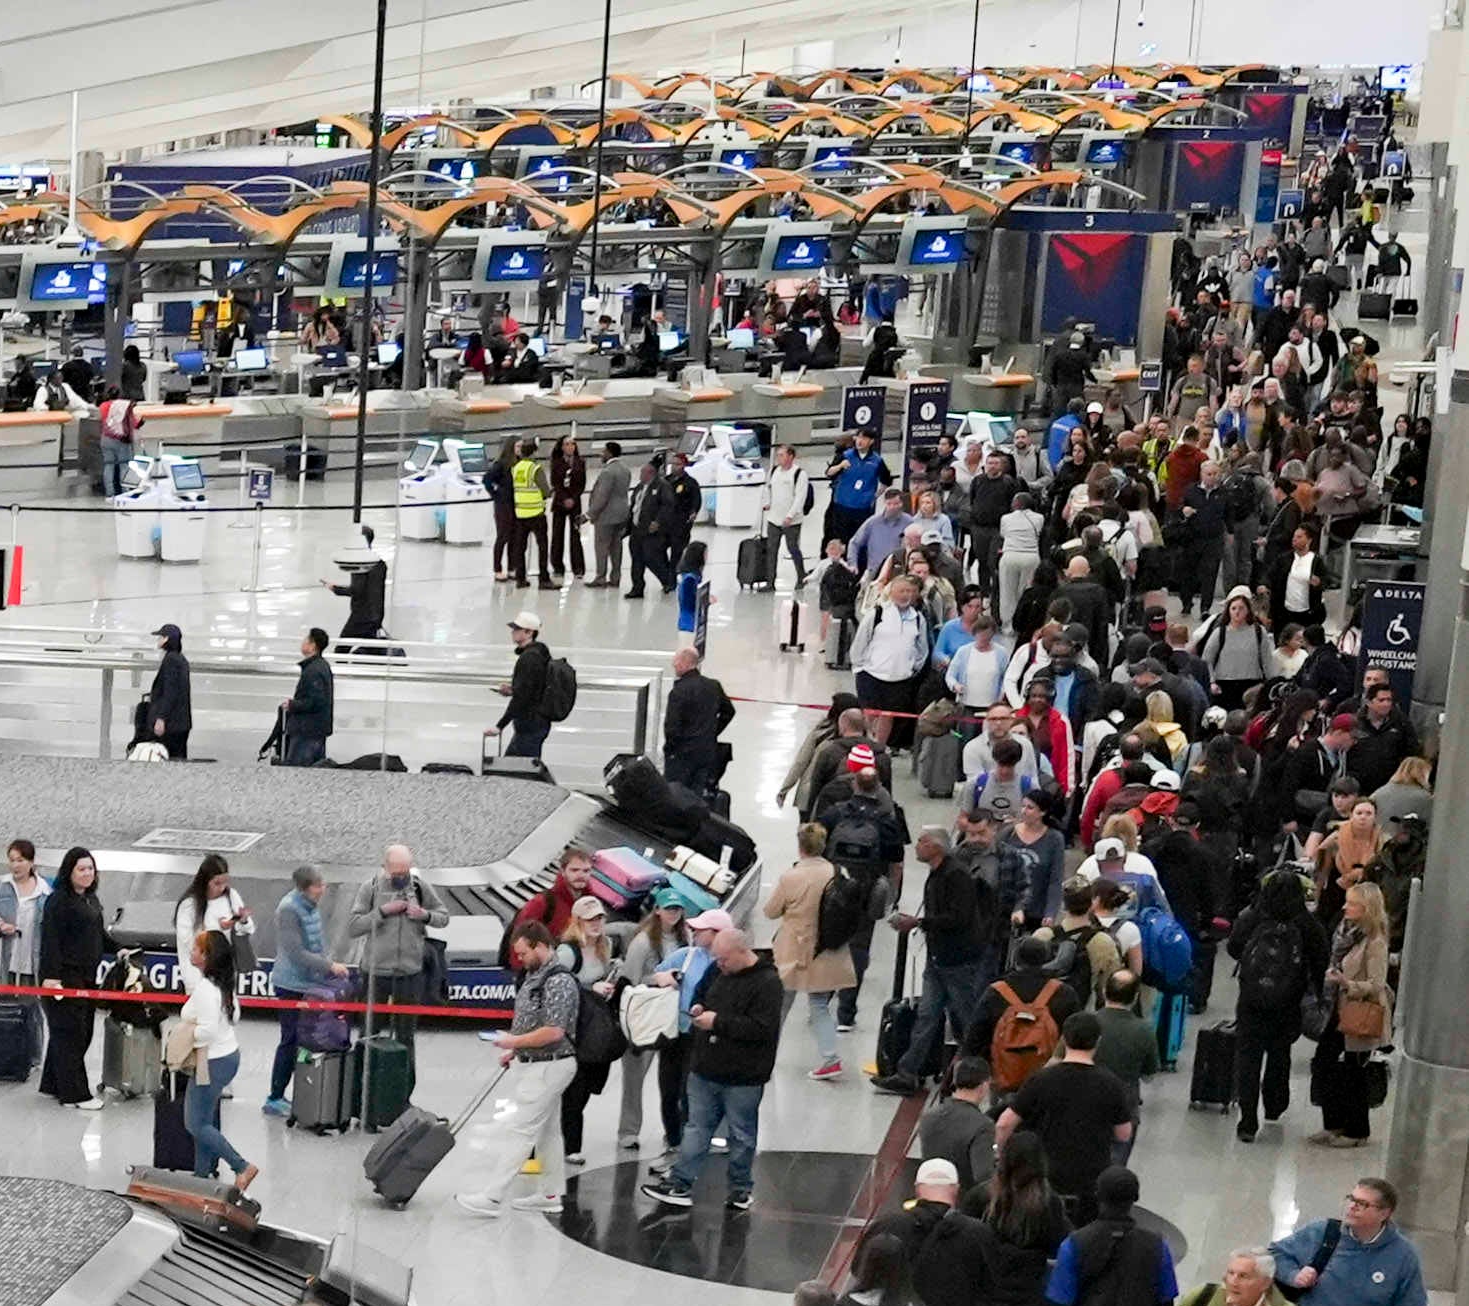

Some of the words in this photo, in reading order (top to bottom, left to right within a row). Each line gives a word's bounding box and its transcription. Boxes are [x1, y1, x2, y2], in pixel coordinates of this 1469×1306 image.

[1203, 130, 1211, 139] 2
[1084, 214, 1095, 228] 3
[1385, 589, 1422, 599] DELTA
